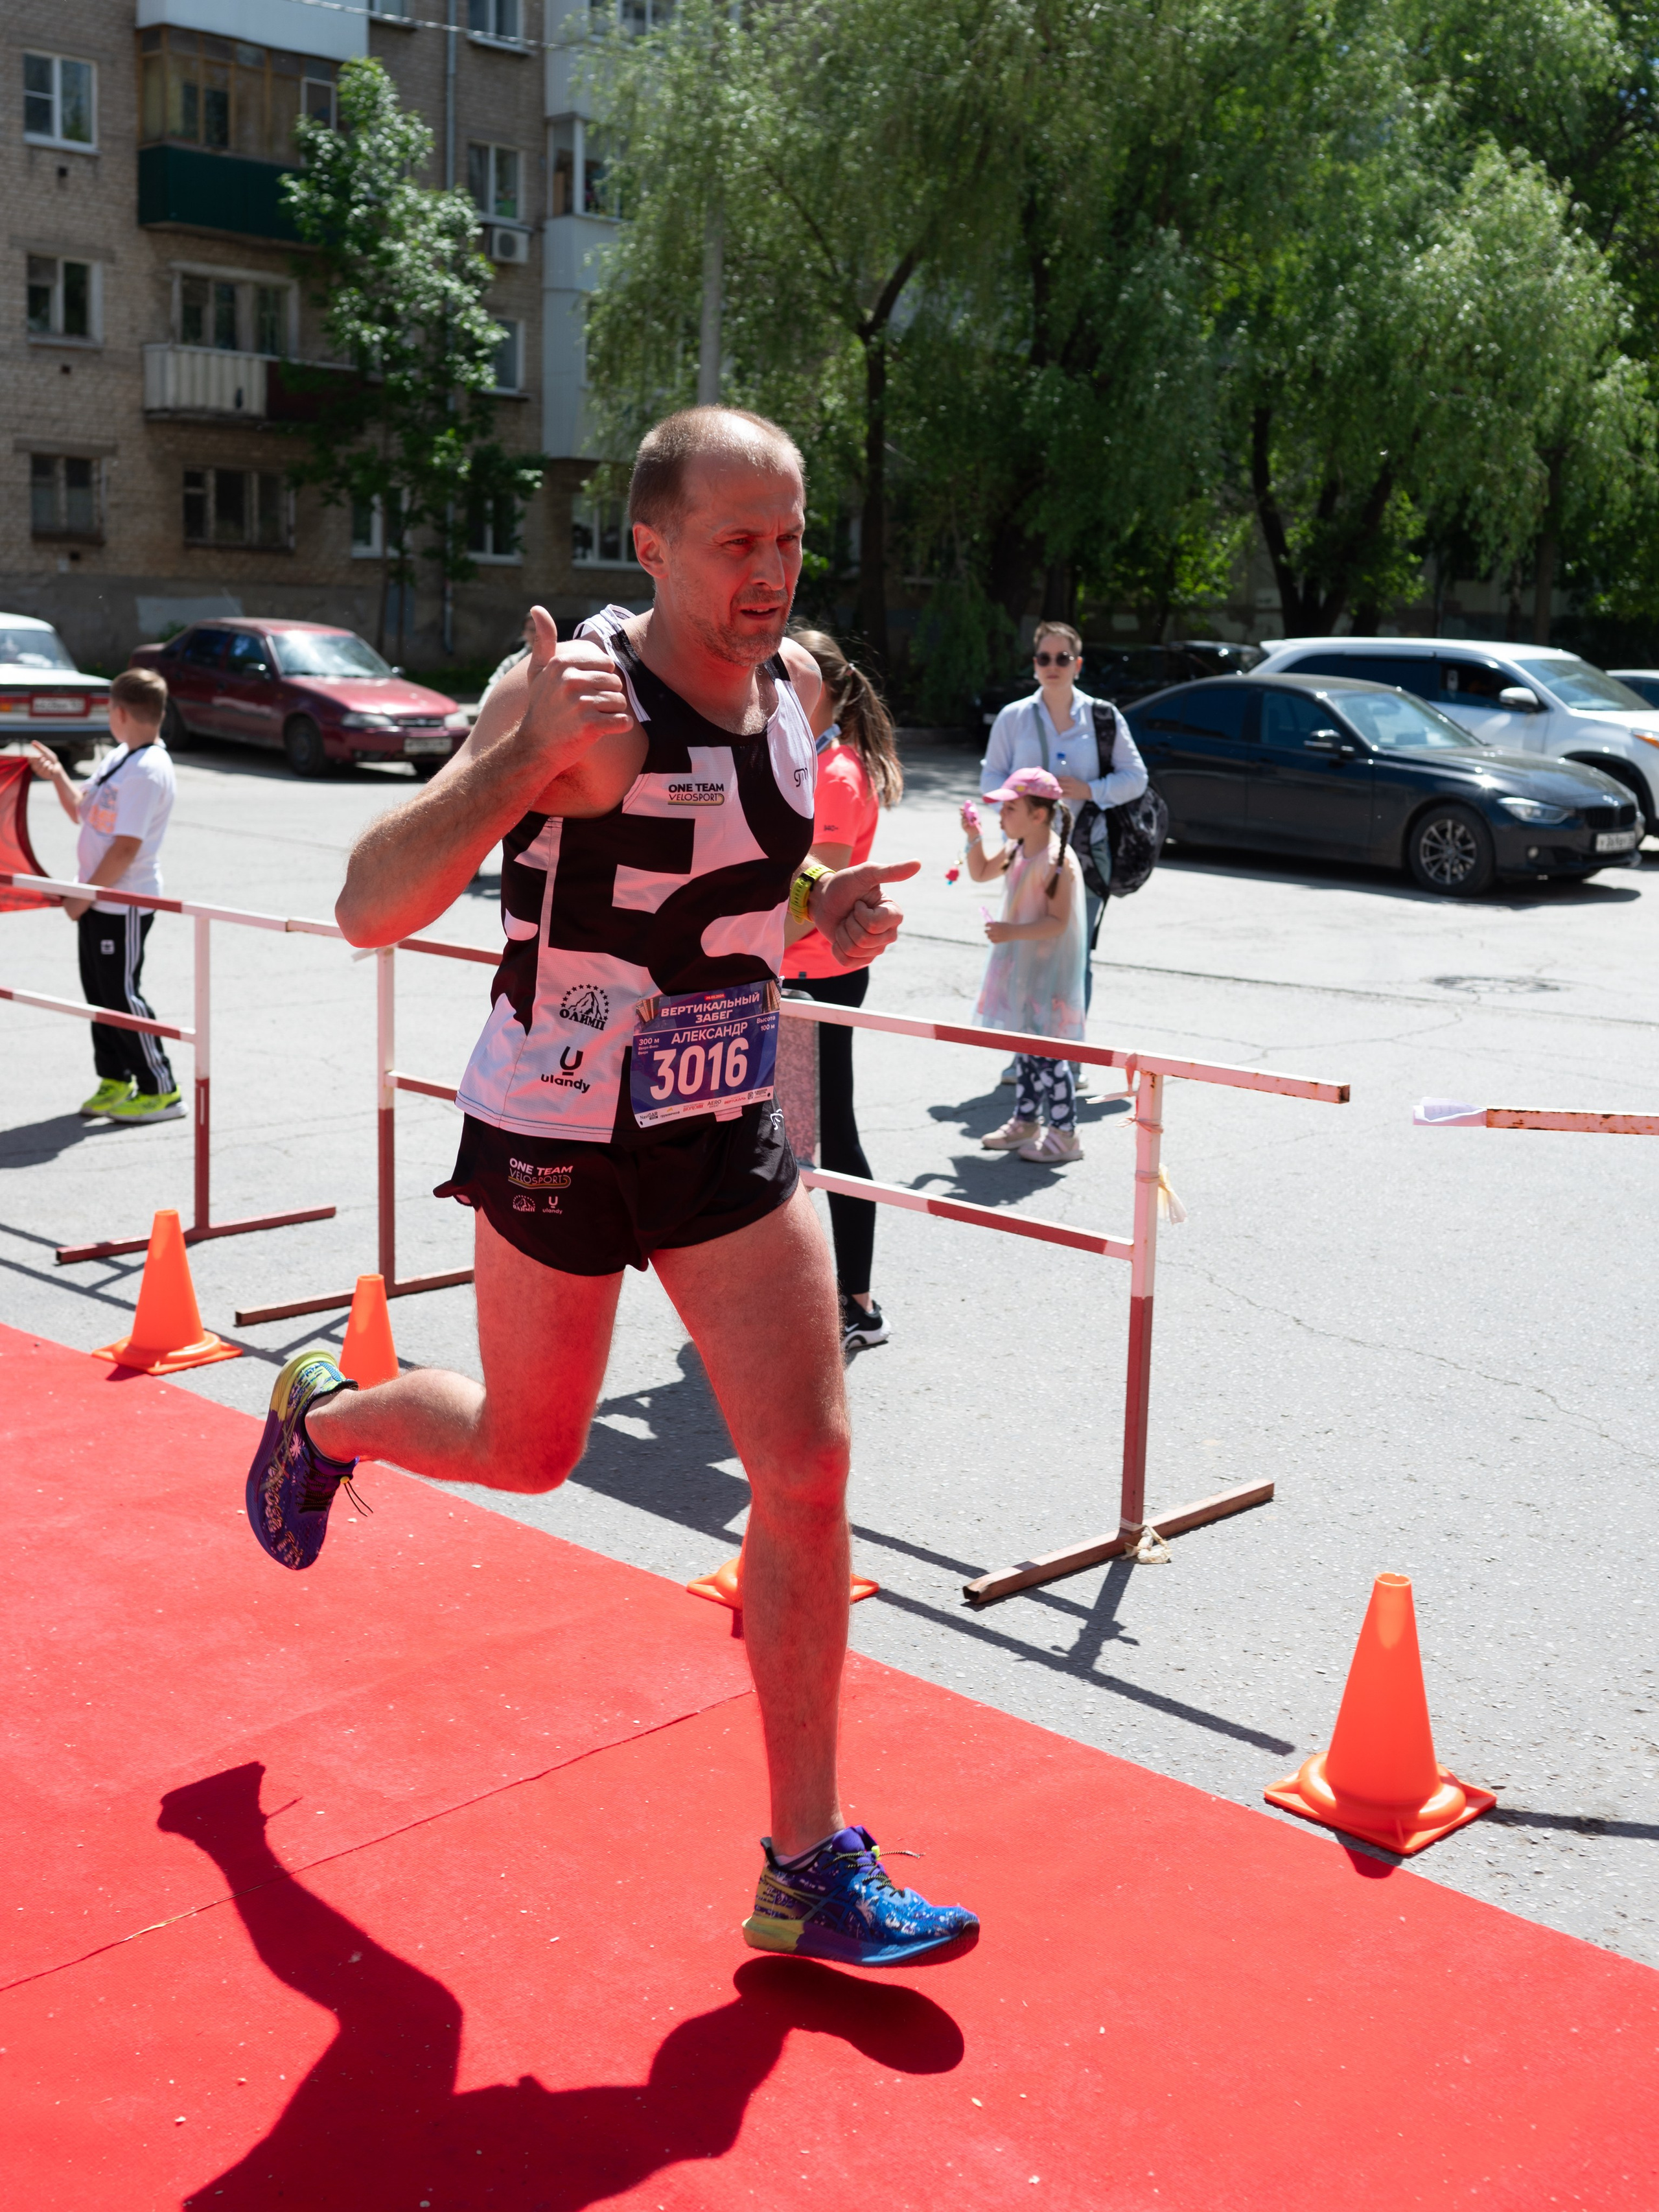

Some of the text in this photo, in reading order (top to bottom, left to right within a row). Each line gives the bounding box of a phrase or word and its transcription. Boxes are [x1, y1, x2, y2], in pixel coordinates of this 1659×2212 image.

[668, 783, 725, 793] ONE TEAM
[669, 793, 718, 802] VELOSPORT
[661, 992, 760, 1017] ВЕРТИКАЛЬНЫЙ
[559, 1008, 606, 1030] ОЛИМП
[695, 1009, 733, 1023] ЗАБЕГ
[756, 1016, 776, 1024] Высота
[671, 1022, 748, 1044] АЛЕКСАНДР
[650, 1037, 749, 1100] 3016
[540, 1073, 590, 1094] ulandy
[509, 1158, 574, 1176] ONE TEAM
[509, 1168, 562, 1185] VELOSPORT
